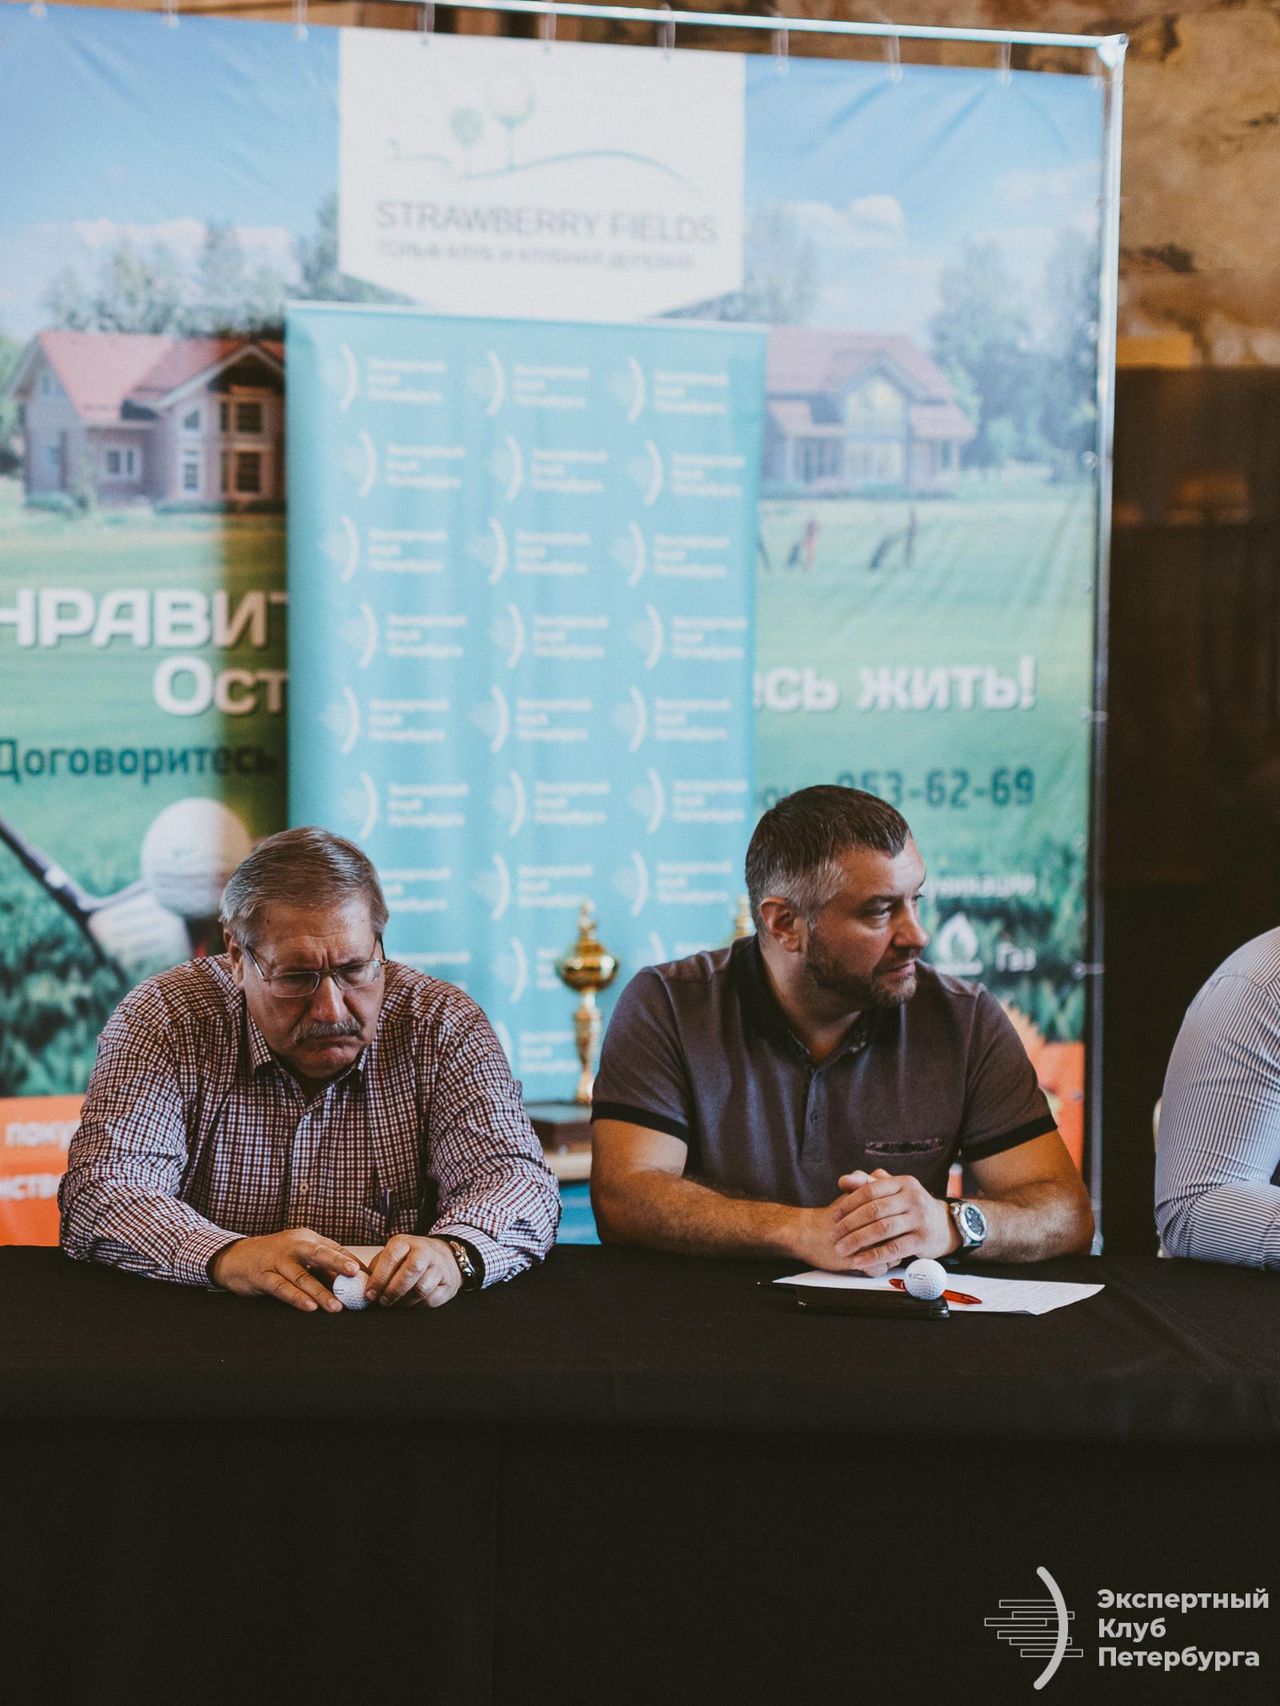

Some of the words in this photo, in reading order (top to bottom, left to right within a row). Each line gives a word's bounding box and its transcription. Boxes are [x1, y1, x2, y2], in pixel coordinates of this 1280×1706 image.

[376, 199, 602, 240] STRAWBERRY
[609, 211, 721, 245] FIELDS
[858, 656, 1036, 711] жить!
